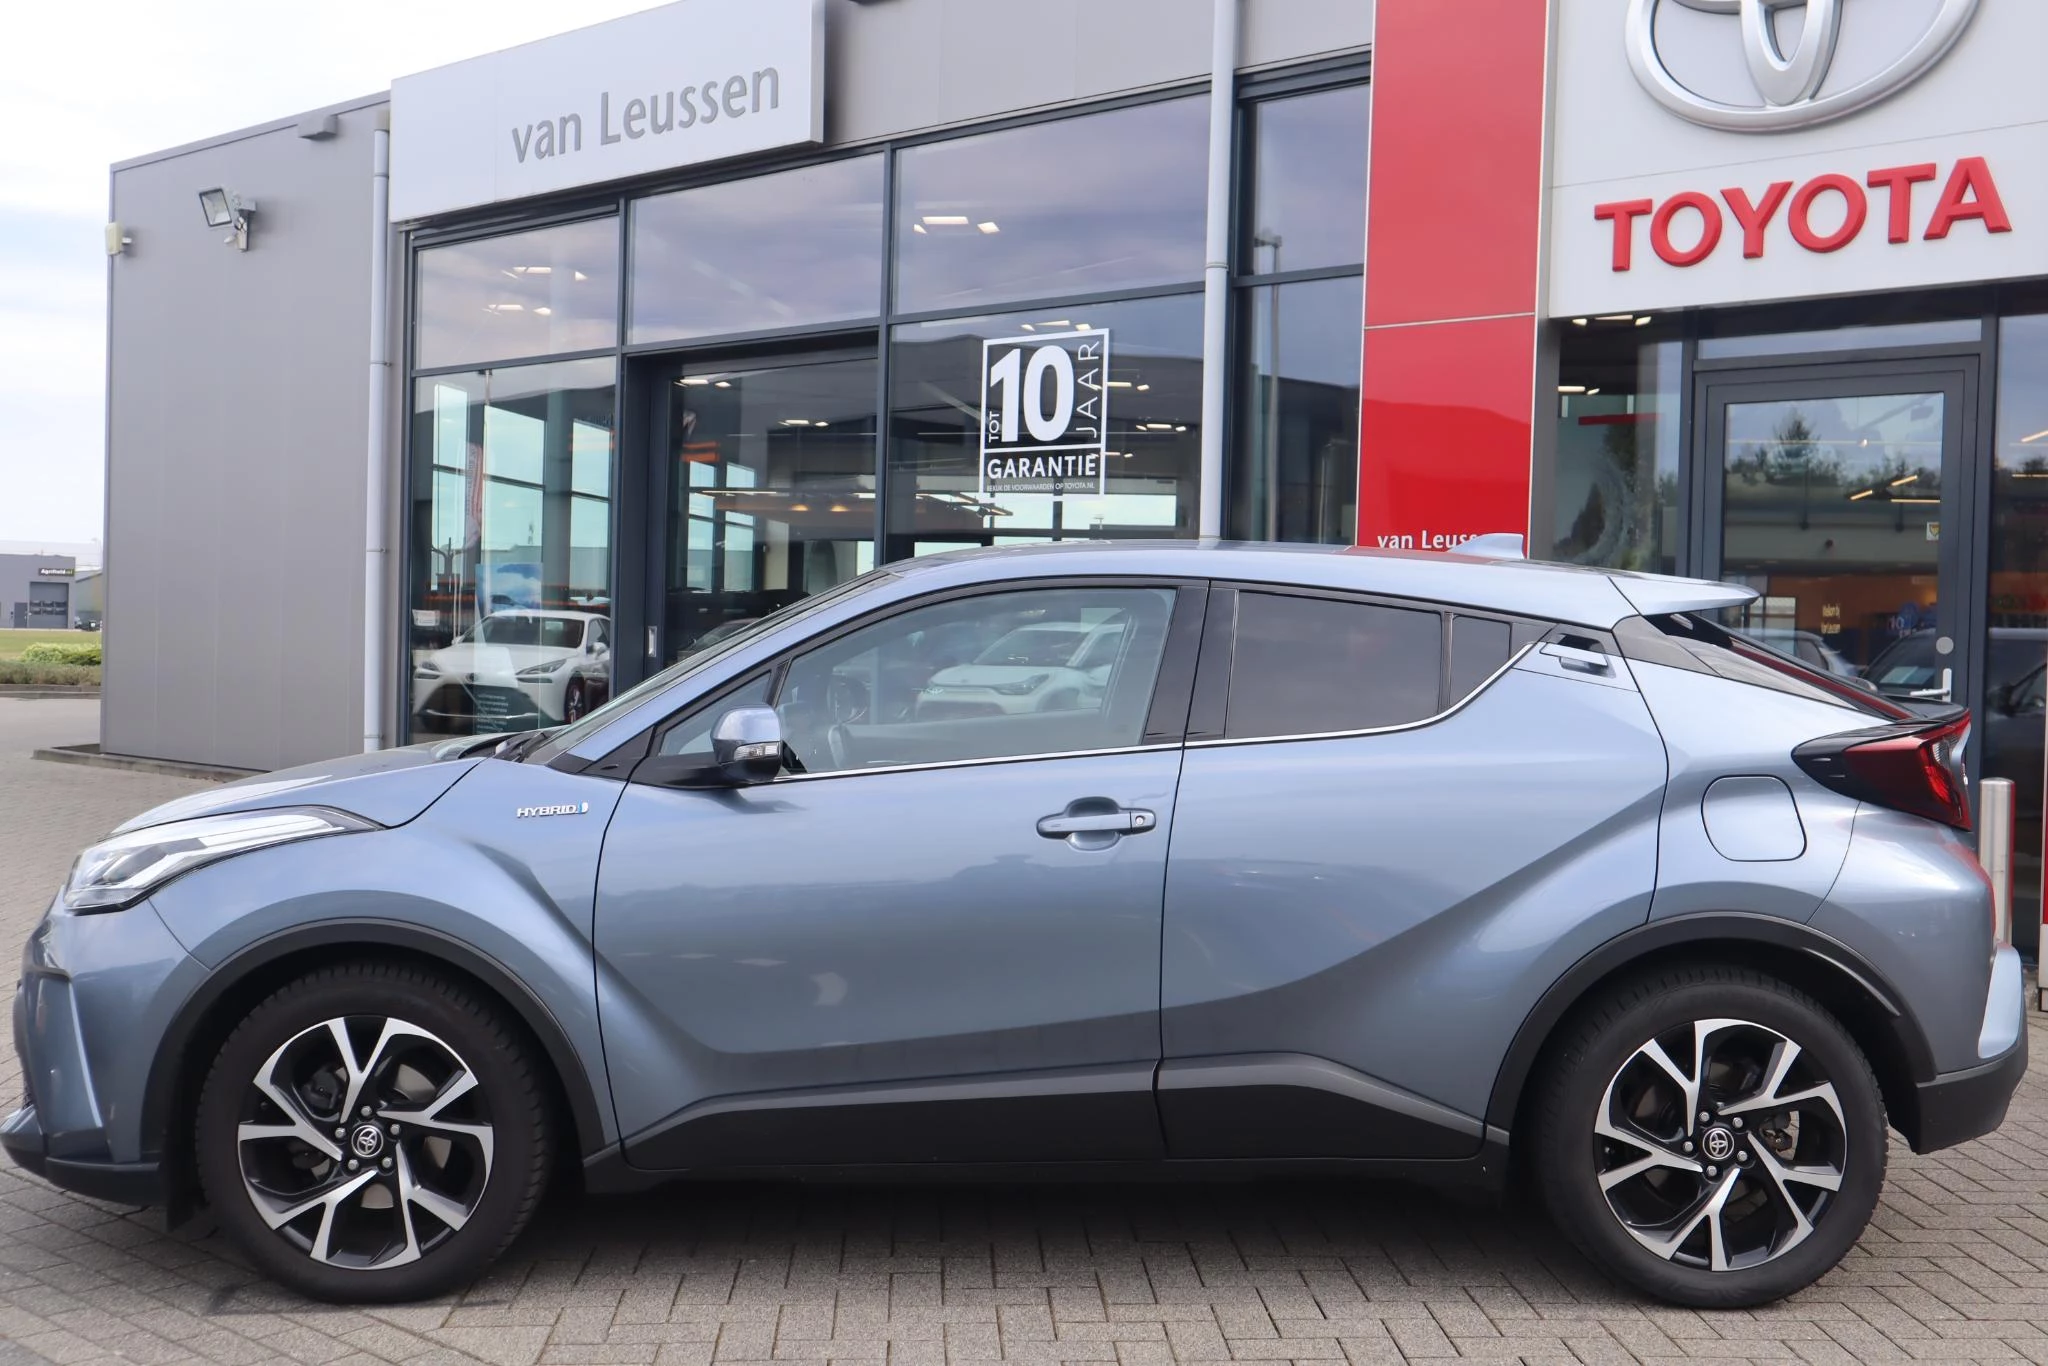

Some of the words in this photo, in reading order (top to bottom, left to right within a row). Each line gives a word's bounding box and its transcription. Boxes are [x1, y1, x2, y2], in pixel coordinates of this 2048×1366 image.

[511, 112, 582, 164] van
[600, 66, 779, 146] Leussen
[1594, 156, 2013, 273] TOYOTA
[990, 345, 1075, 443] 10
[1075, 340, 1100, 439] JAAR
[988, 411, 1001, 444] TOT
[987, 454, 1097, 480] GARANTIE
[1055, 482, 1064, 490] OP
[1377, 534, 1413, 549] van
[516, 804, 577, 818] HYBRID
